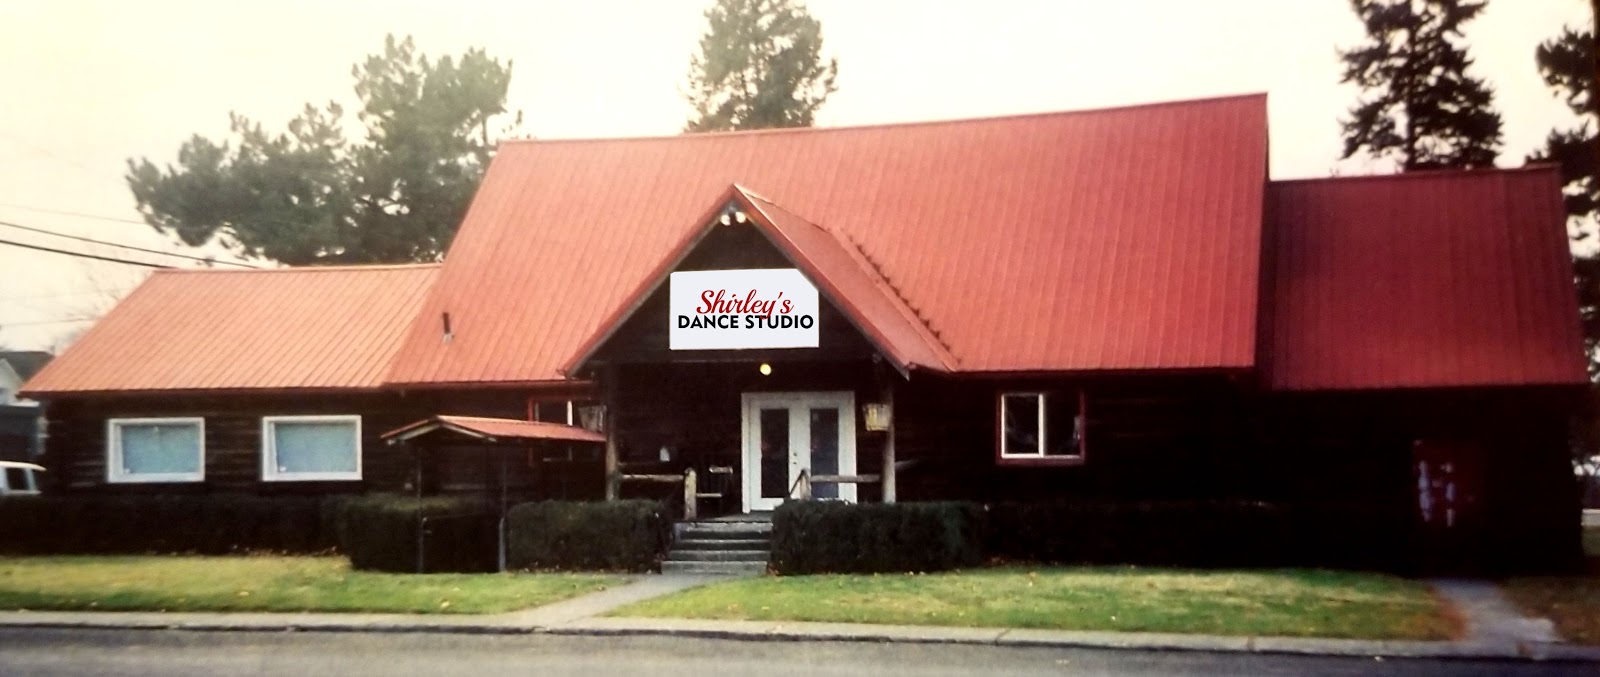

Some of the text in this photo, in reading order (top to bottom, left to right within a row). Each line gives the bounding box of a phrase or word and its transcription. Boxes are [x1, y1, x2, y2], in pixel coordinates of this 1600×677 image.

[696, 289, 794, 320] Shirley's
[678, 315, 814, 329] DANCE STUDIO
